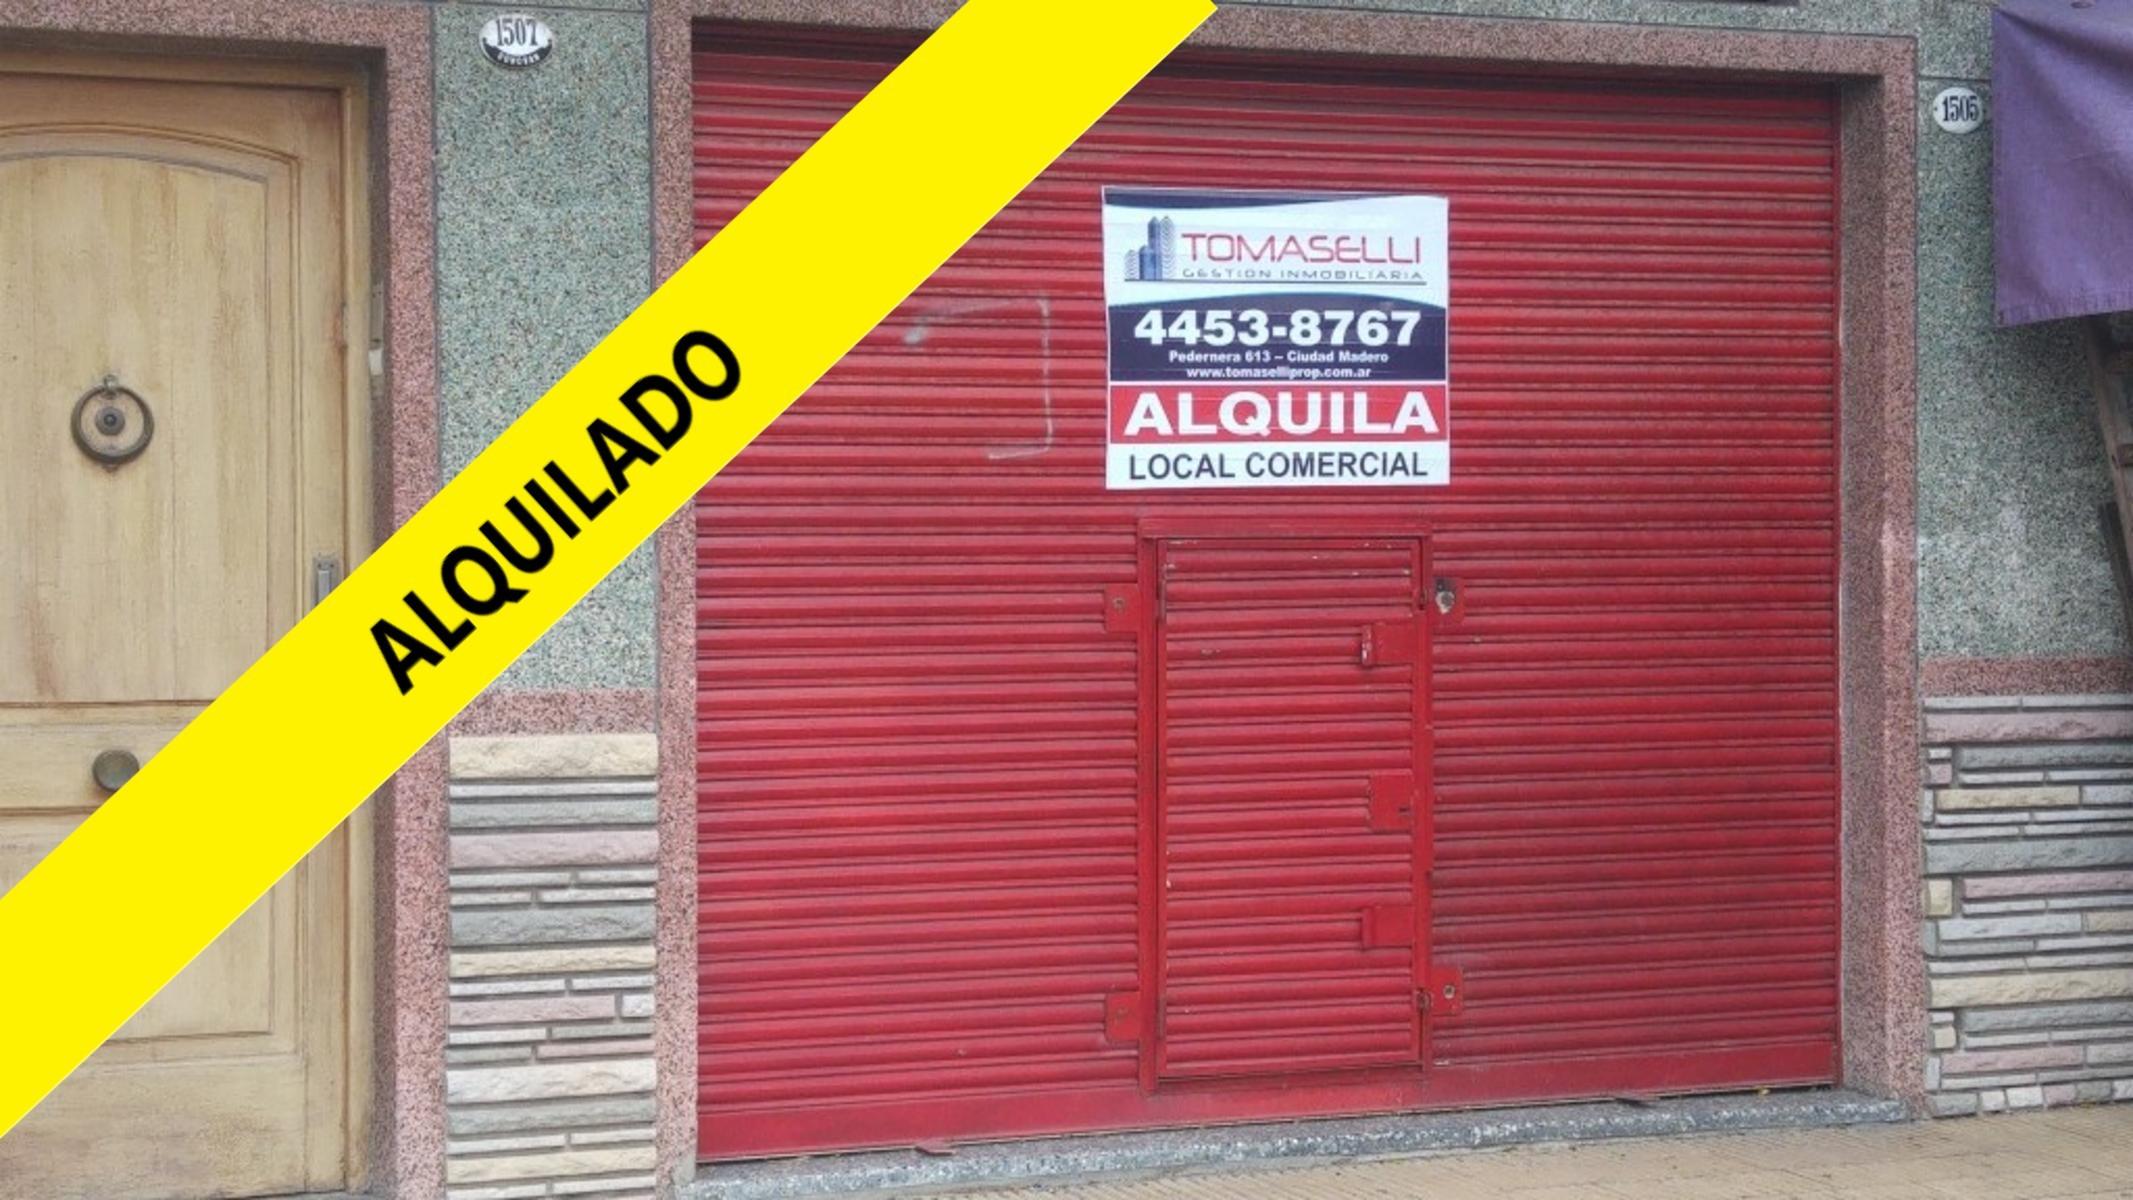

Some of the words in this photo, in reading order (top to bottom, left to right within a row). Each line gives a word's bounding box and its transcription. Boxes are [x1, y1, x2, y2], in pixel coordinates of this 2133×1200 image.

[496, 18, 538, 46] 1507
[1942, 95, 1979, 121] 1505
[1181, 233, 1421, 264] TOMASELLI
[1182, 268, 1272, 279] GESTION
[1280, 270, 1423, 281] INMOBILIARIA
[1134, 309, 1421, 346] 4453-8767
[1169, 350, 1240, 363] Pedernera
[1245, 350, 1271, 363] 613
[1287, 350, 1334, 363] Ciudad
[1338, 350, 1389, 363] Madero
[1186, 366, 1371, 380] www.tomaselliprop.com.ar
[1123, 391, 1439, 437] ALQUILA
[1129, 453, 1235, 480] LOCAL
[1245, 451, 1428, 478] COMERCIAL
